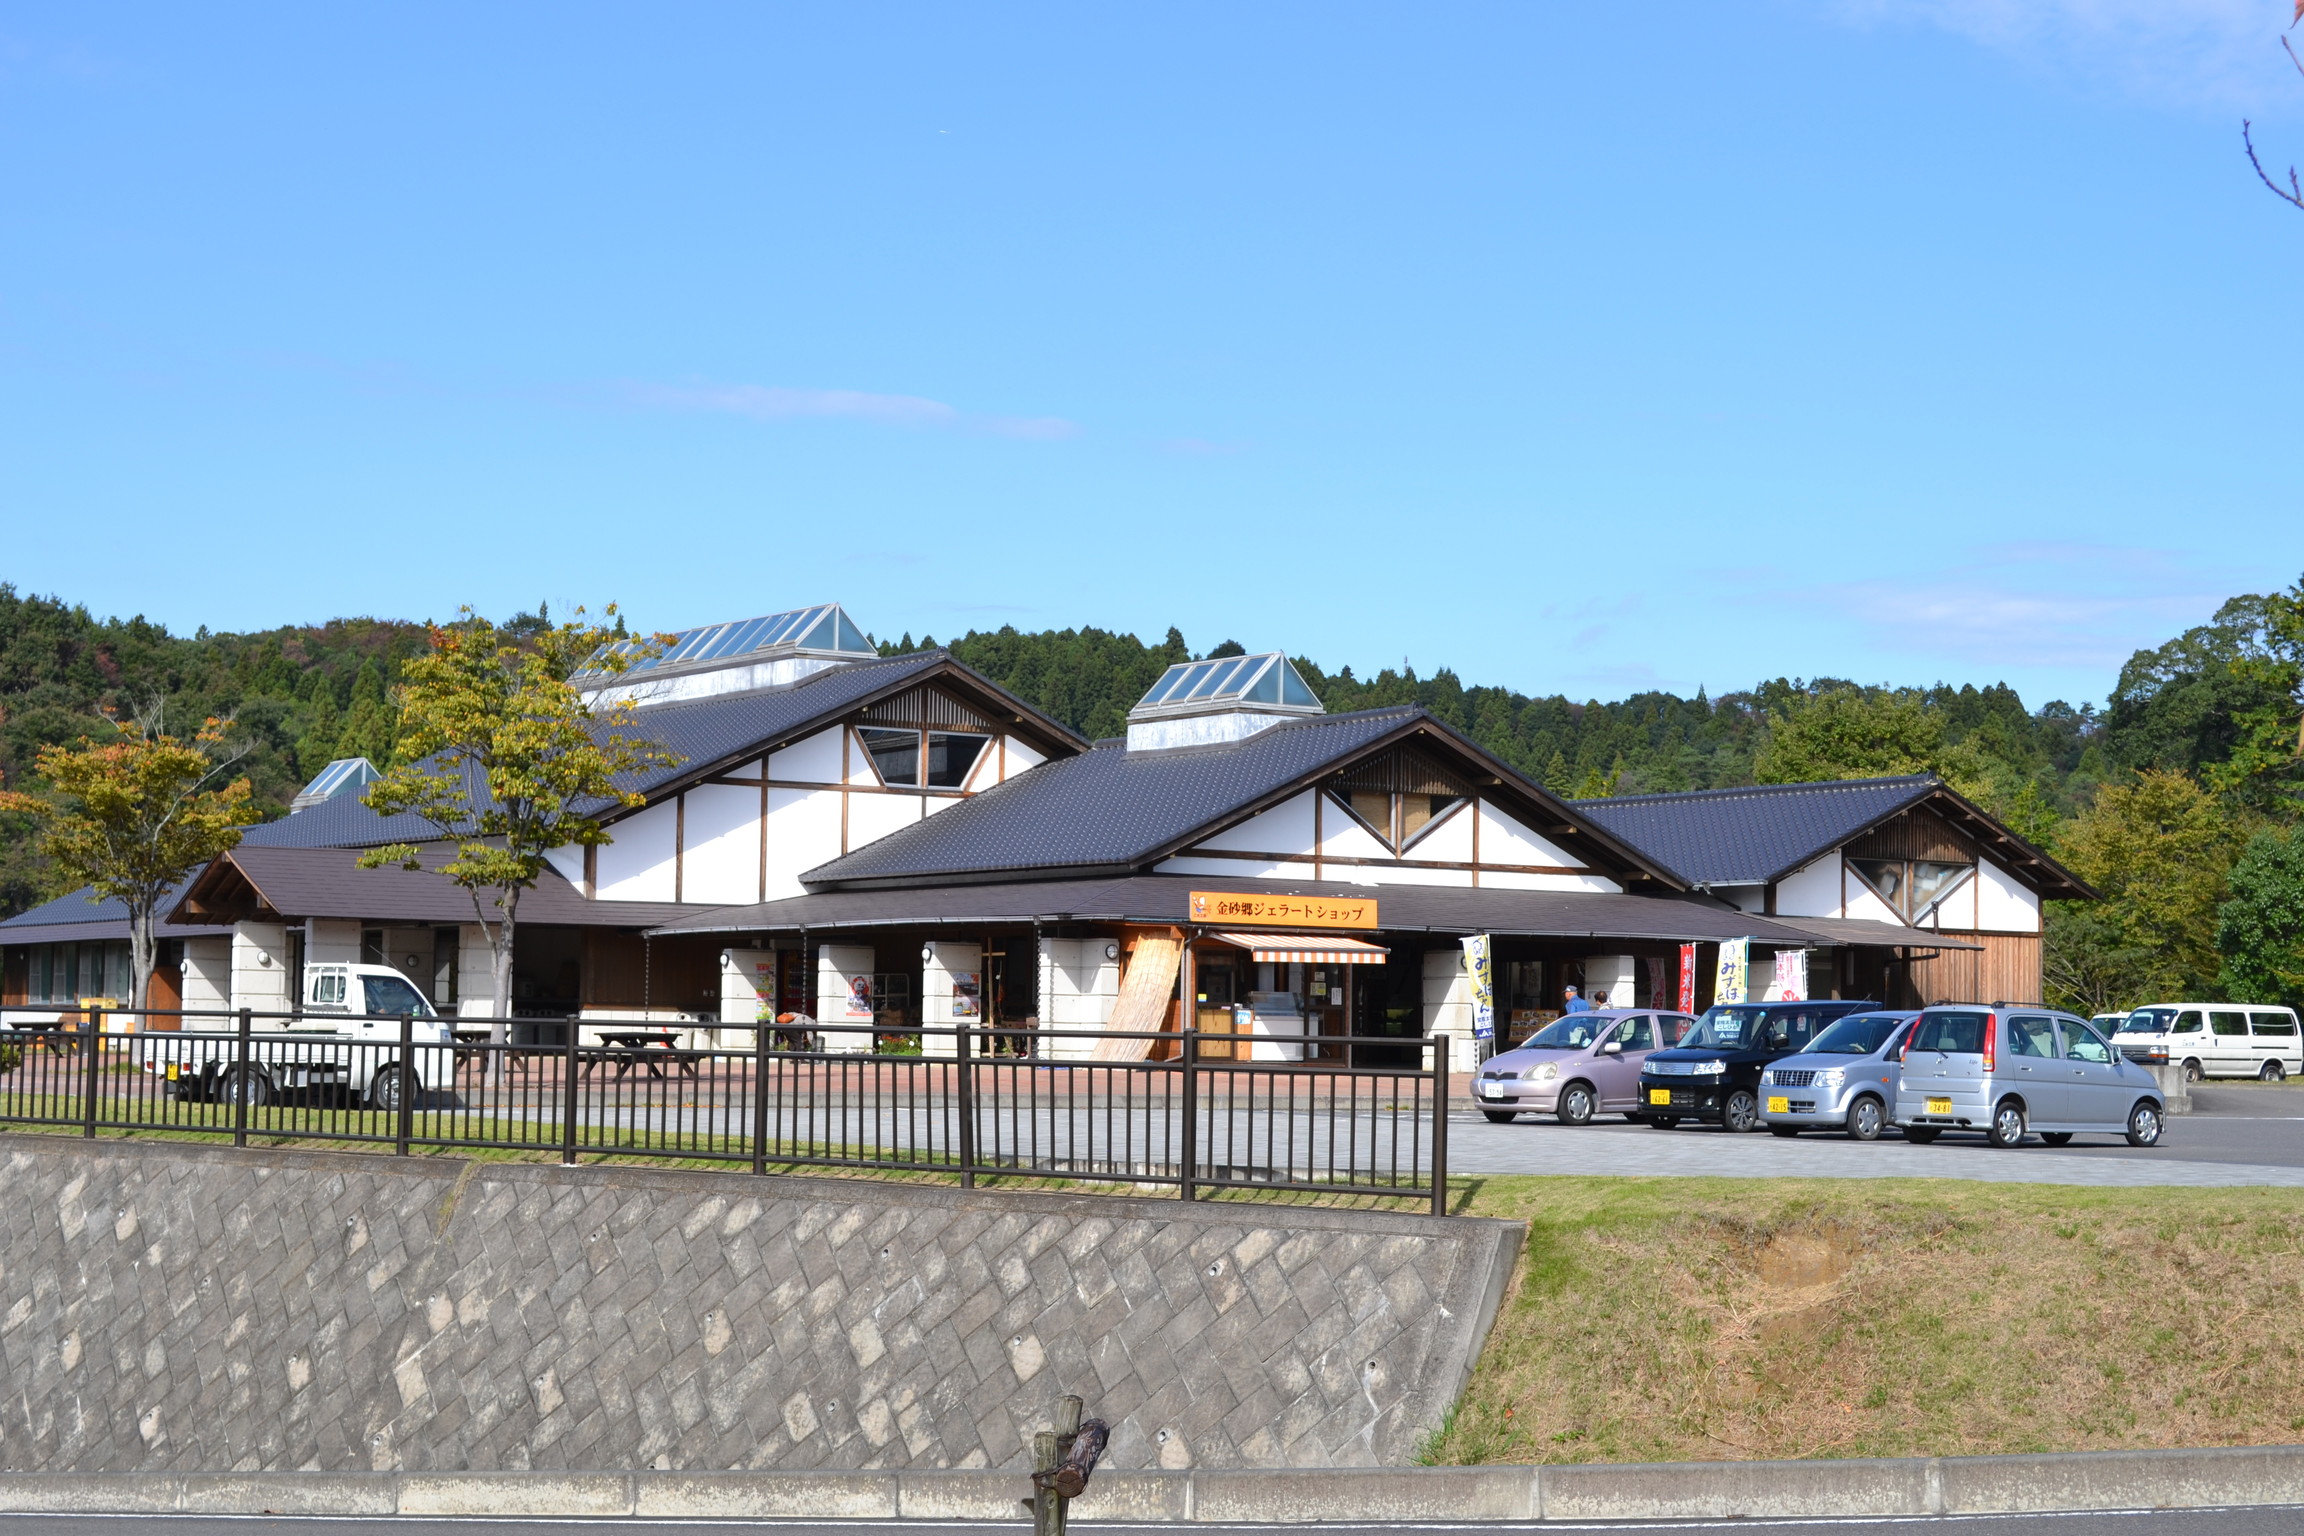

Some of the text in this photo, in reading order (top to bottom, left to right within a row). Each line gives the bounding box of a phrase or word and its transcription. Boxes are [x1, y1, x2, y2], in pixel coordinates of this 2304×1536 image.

[1217, 900, 1364, 921] 金砂郷ジェラートショップ
